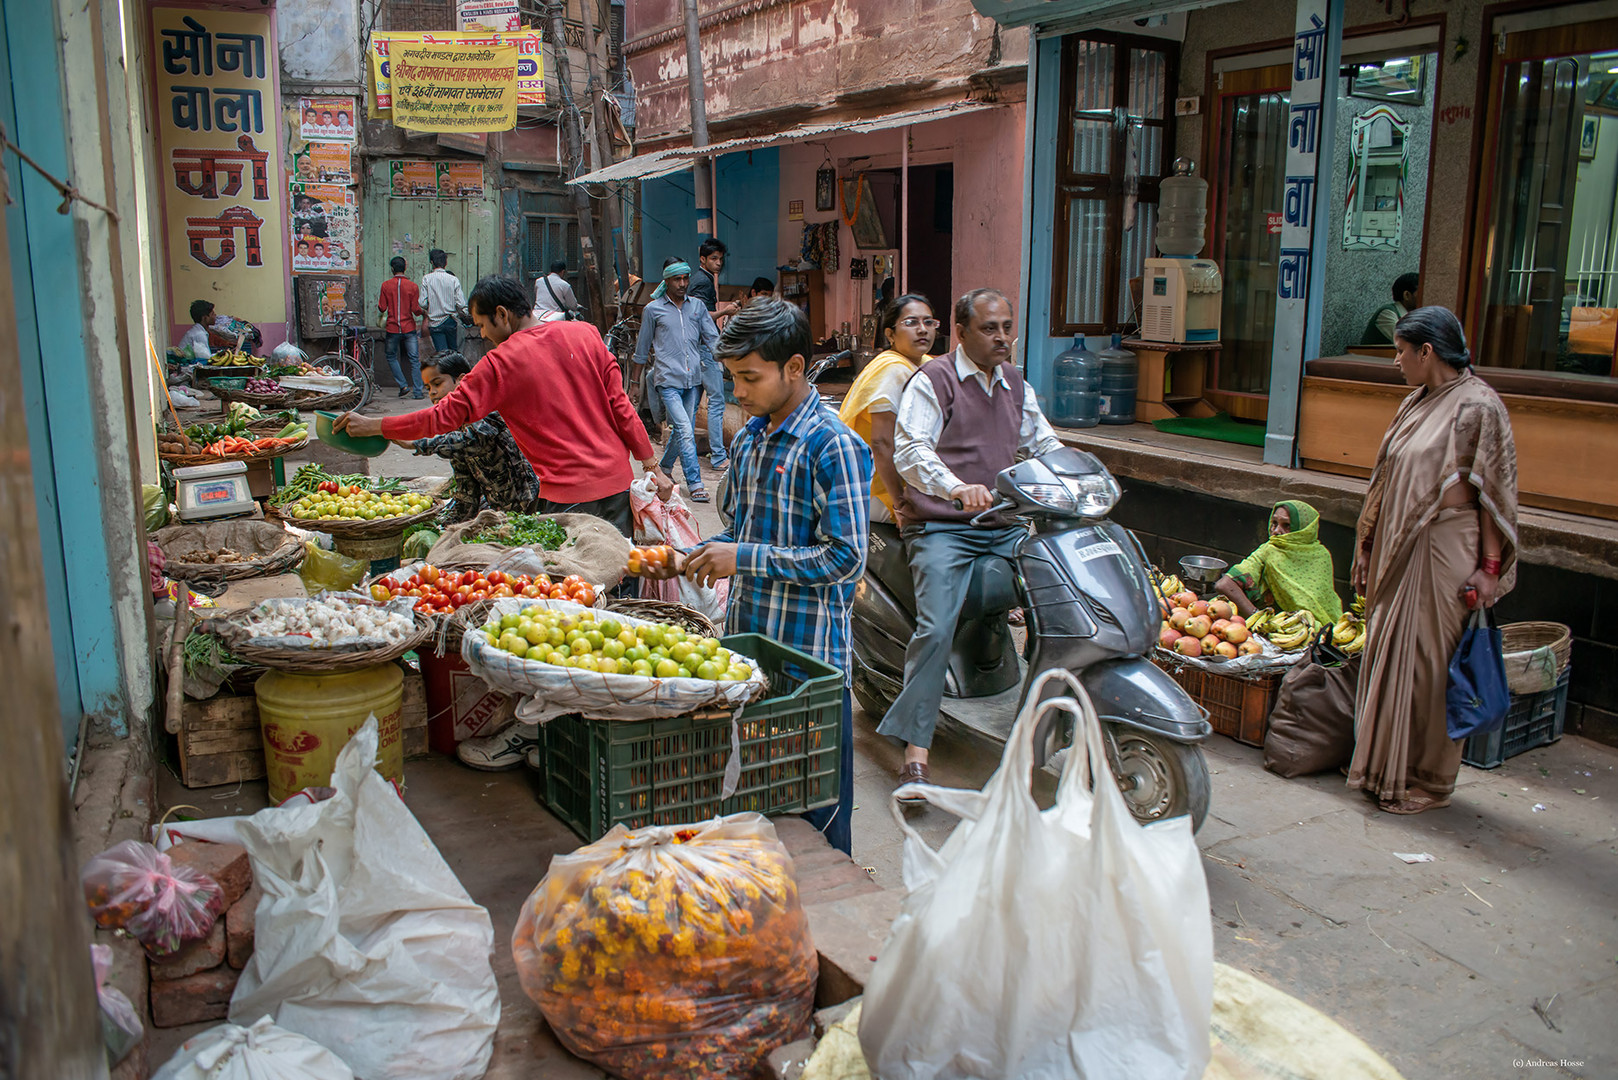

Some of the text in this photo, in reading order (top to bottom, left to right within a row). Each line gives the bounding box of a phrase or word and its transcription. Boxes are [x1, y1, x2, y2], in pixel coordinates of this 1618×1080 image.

[161, 15, 266, 80] सोना
[466, 50, 496, 61] आयोजित
[418, 66, 445, 81] भागवत
[433, 87, 465, 99] भागवत
[465, 84, 505, 99] सम्मेलन
[170, 85, 264, 134] वाला
